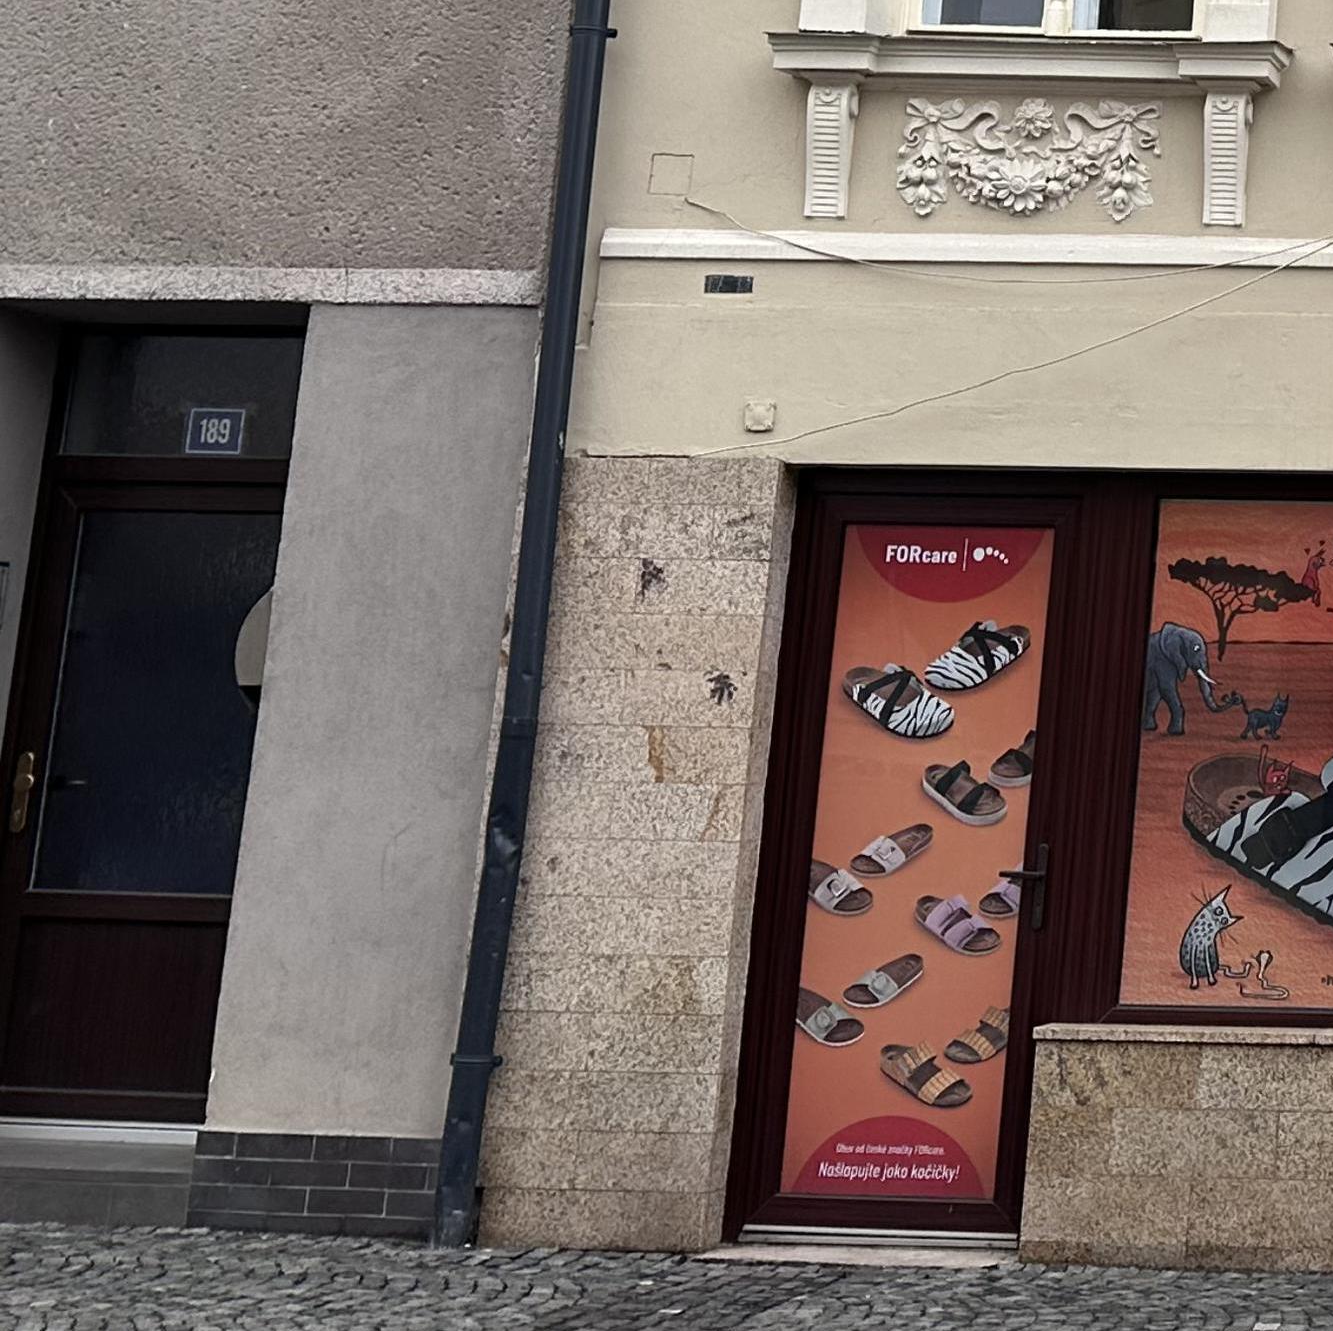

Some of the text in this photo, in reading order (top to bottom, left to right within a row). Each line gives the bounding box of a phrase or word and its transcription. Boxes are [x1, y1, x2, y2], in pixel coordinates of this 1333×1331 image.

[200, 418, 231, 444] 189
[885, 544, 958, 564] FORcare
[818, 1160, 960, 1183] Našlapujte jako kočičky!
